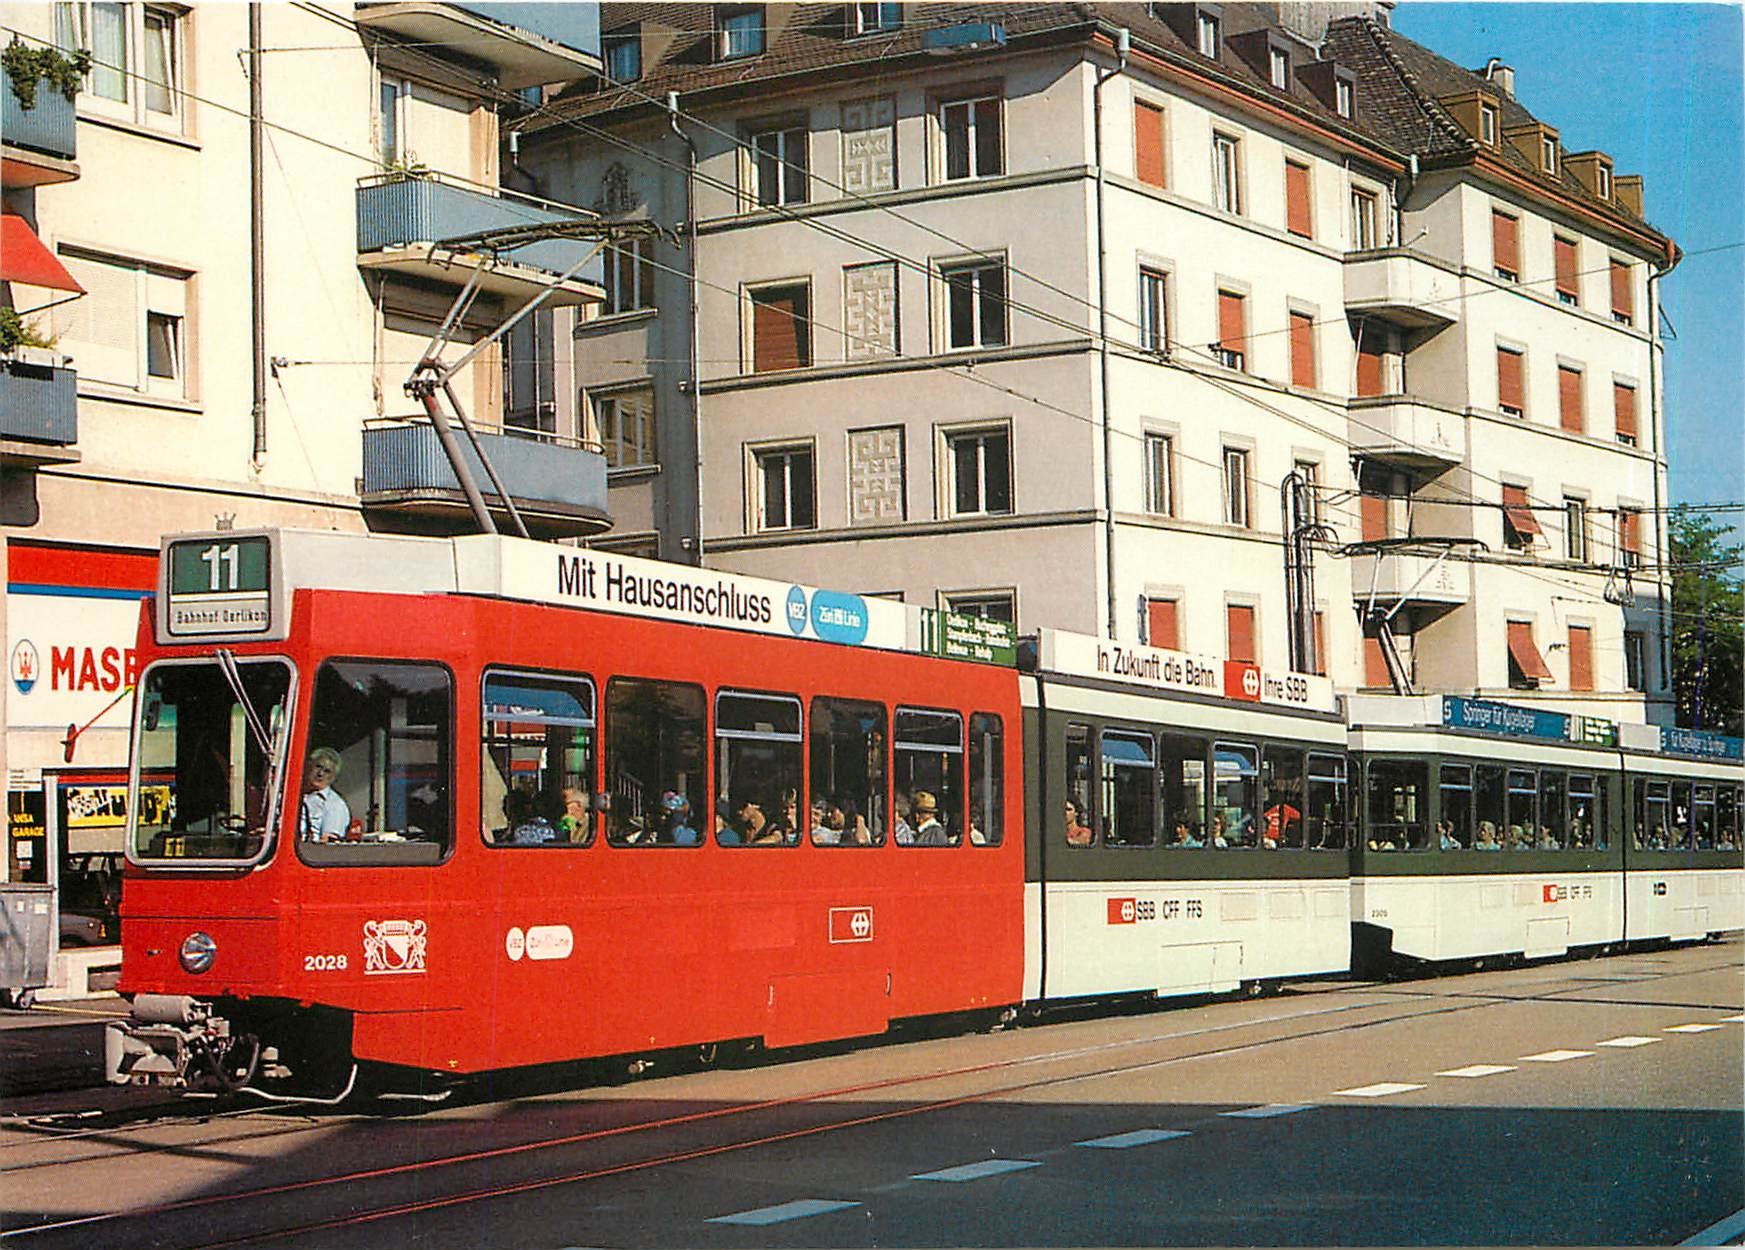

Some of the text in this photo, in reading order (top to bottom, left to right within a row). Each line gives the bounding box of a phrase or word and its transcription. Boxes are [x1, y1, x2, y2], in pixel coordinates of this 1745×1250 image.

[201, 544, 239, 590] 11
[558, 554, 773, 624] Mit Hausanschluss
[176, 609, 268, 625] Bahnhof Oerlikon
[921, 609, 938, 653] 11
[1096, 644, 1218, 689] In Zukunft die Bahn.
[1263, 672, 1308, 702] Ihre SBB
[1136, 900, 1203, 920] SBB CFF FFS
[304, 954, 348, 972] 2028
